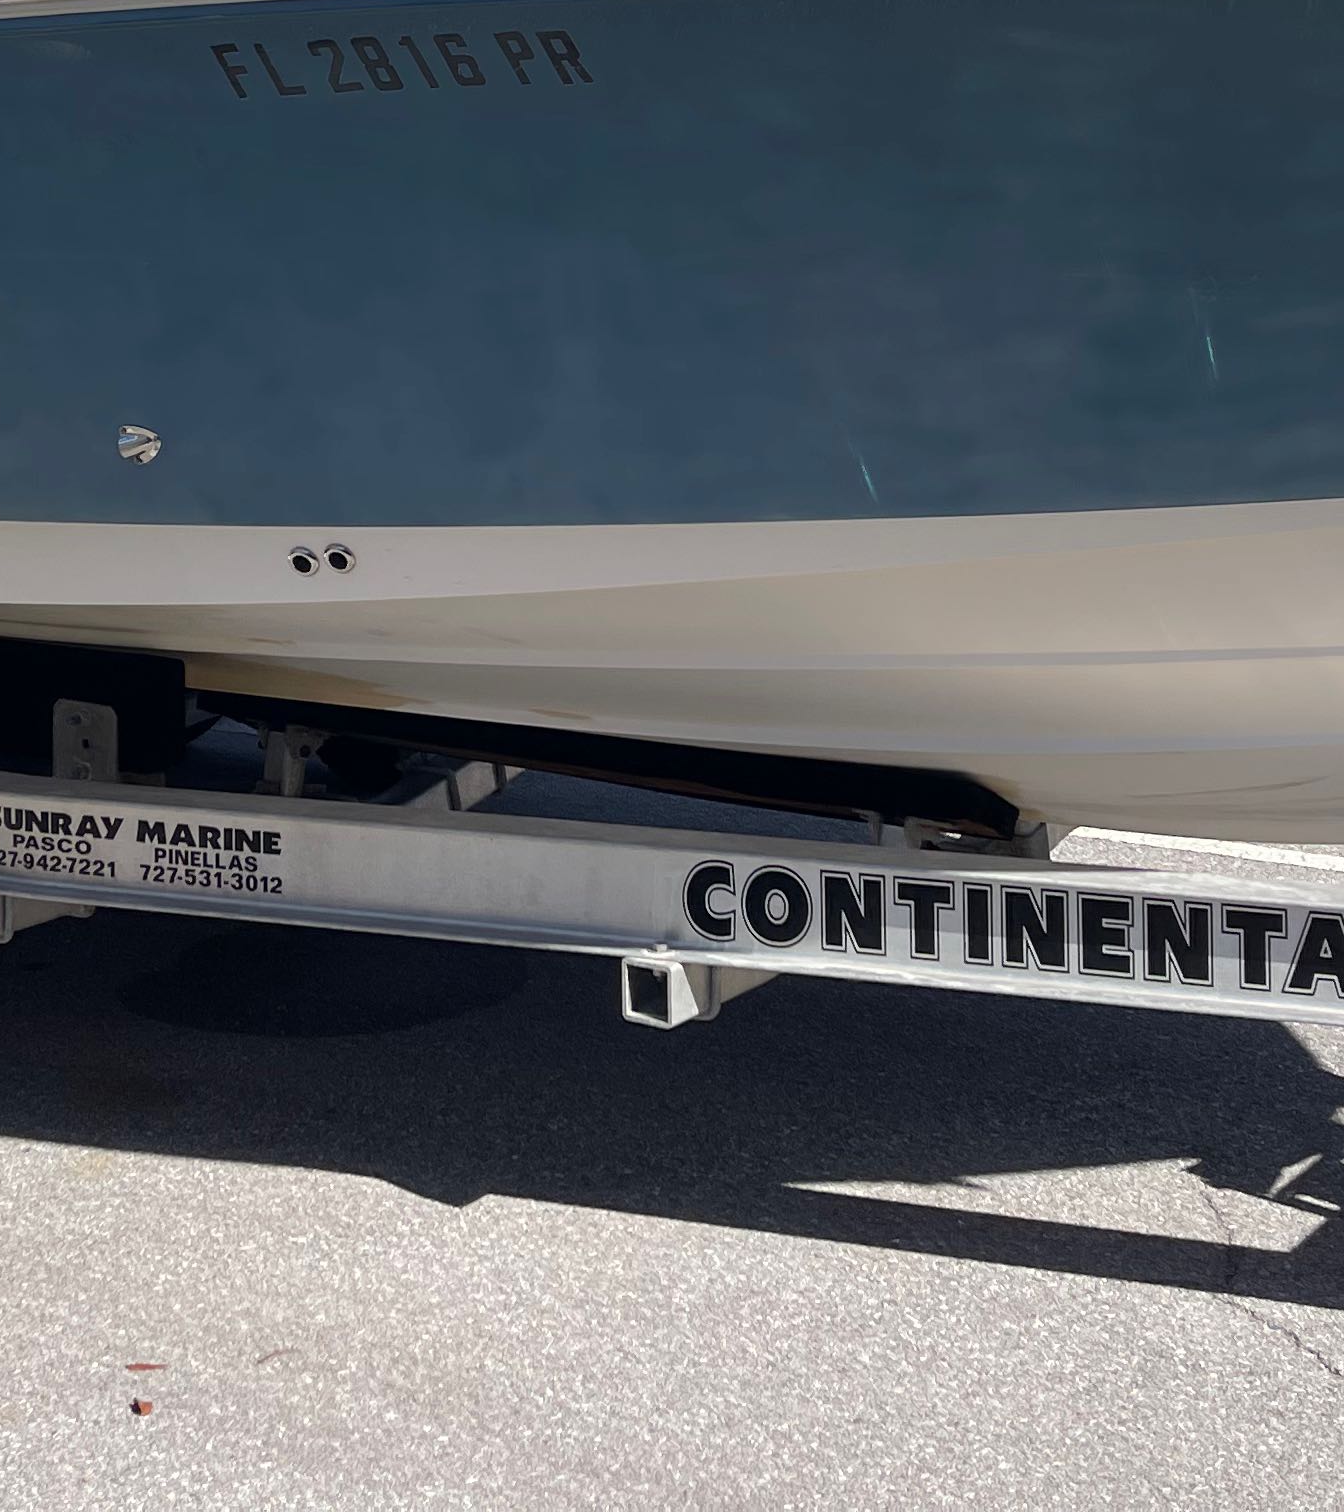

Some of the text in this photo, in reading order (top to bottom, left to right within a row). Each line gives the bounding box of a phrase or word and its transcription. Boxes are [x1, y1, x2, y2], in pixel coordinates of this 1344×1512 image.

[209, 29, 595, 99] FL 2816 PR
[12, 833, 92, 855] PASCO
[136, 819, 283, 856] MARINE
[154, 847, 258, 873] PINELLAS
[139, 864, 283, 895] 727-531-3012
